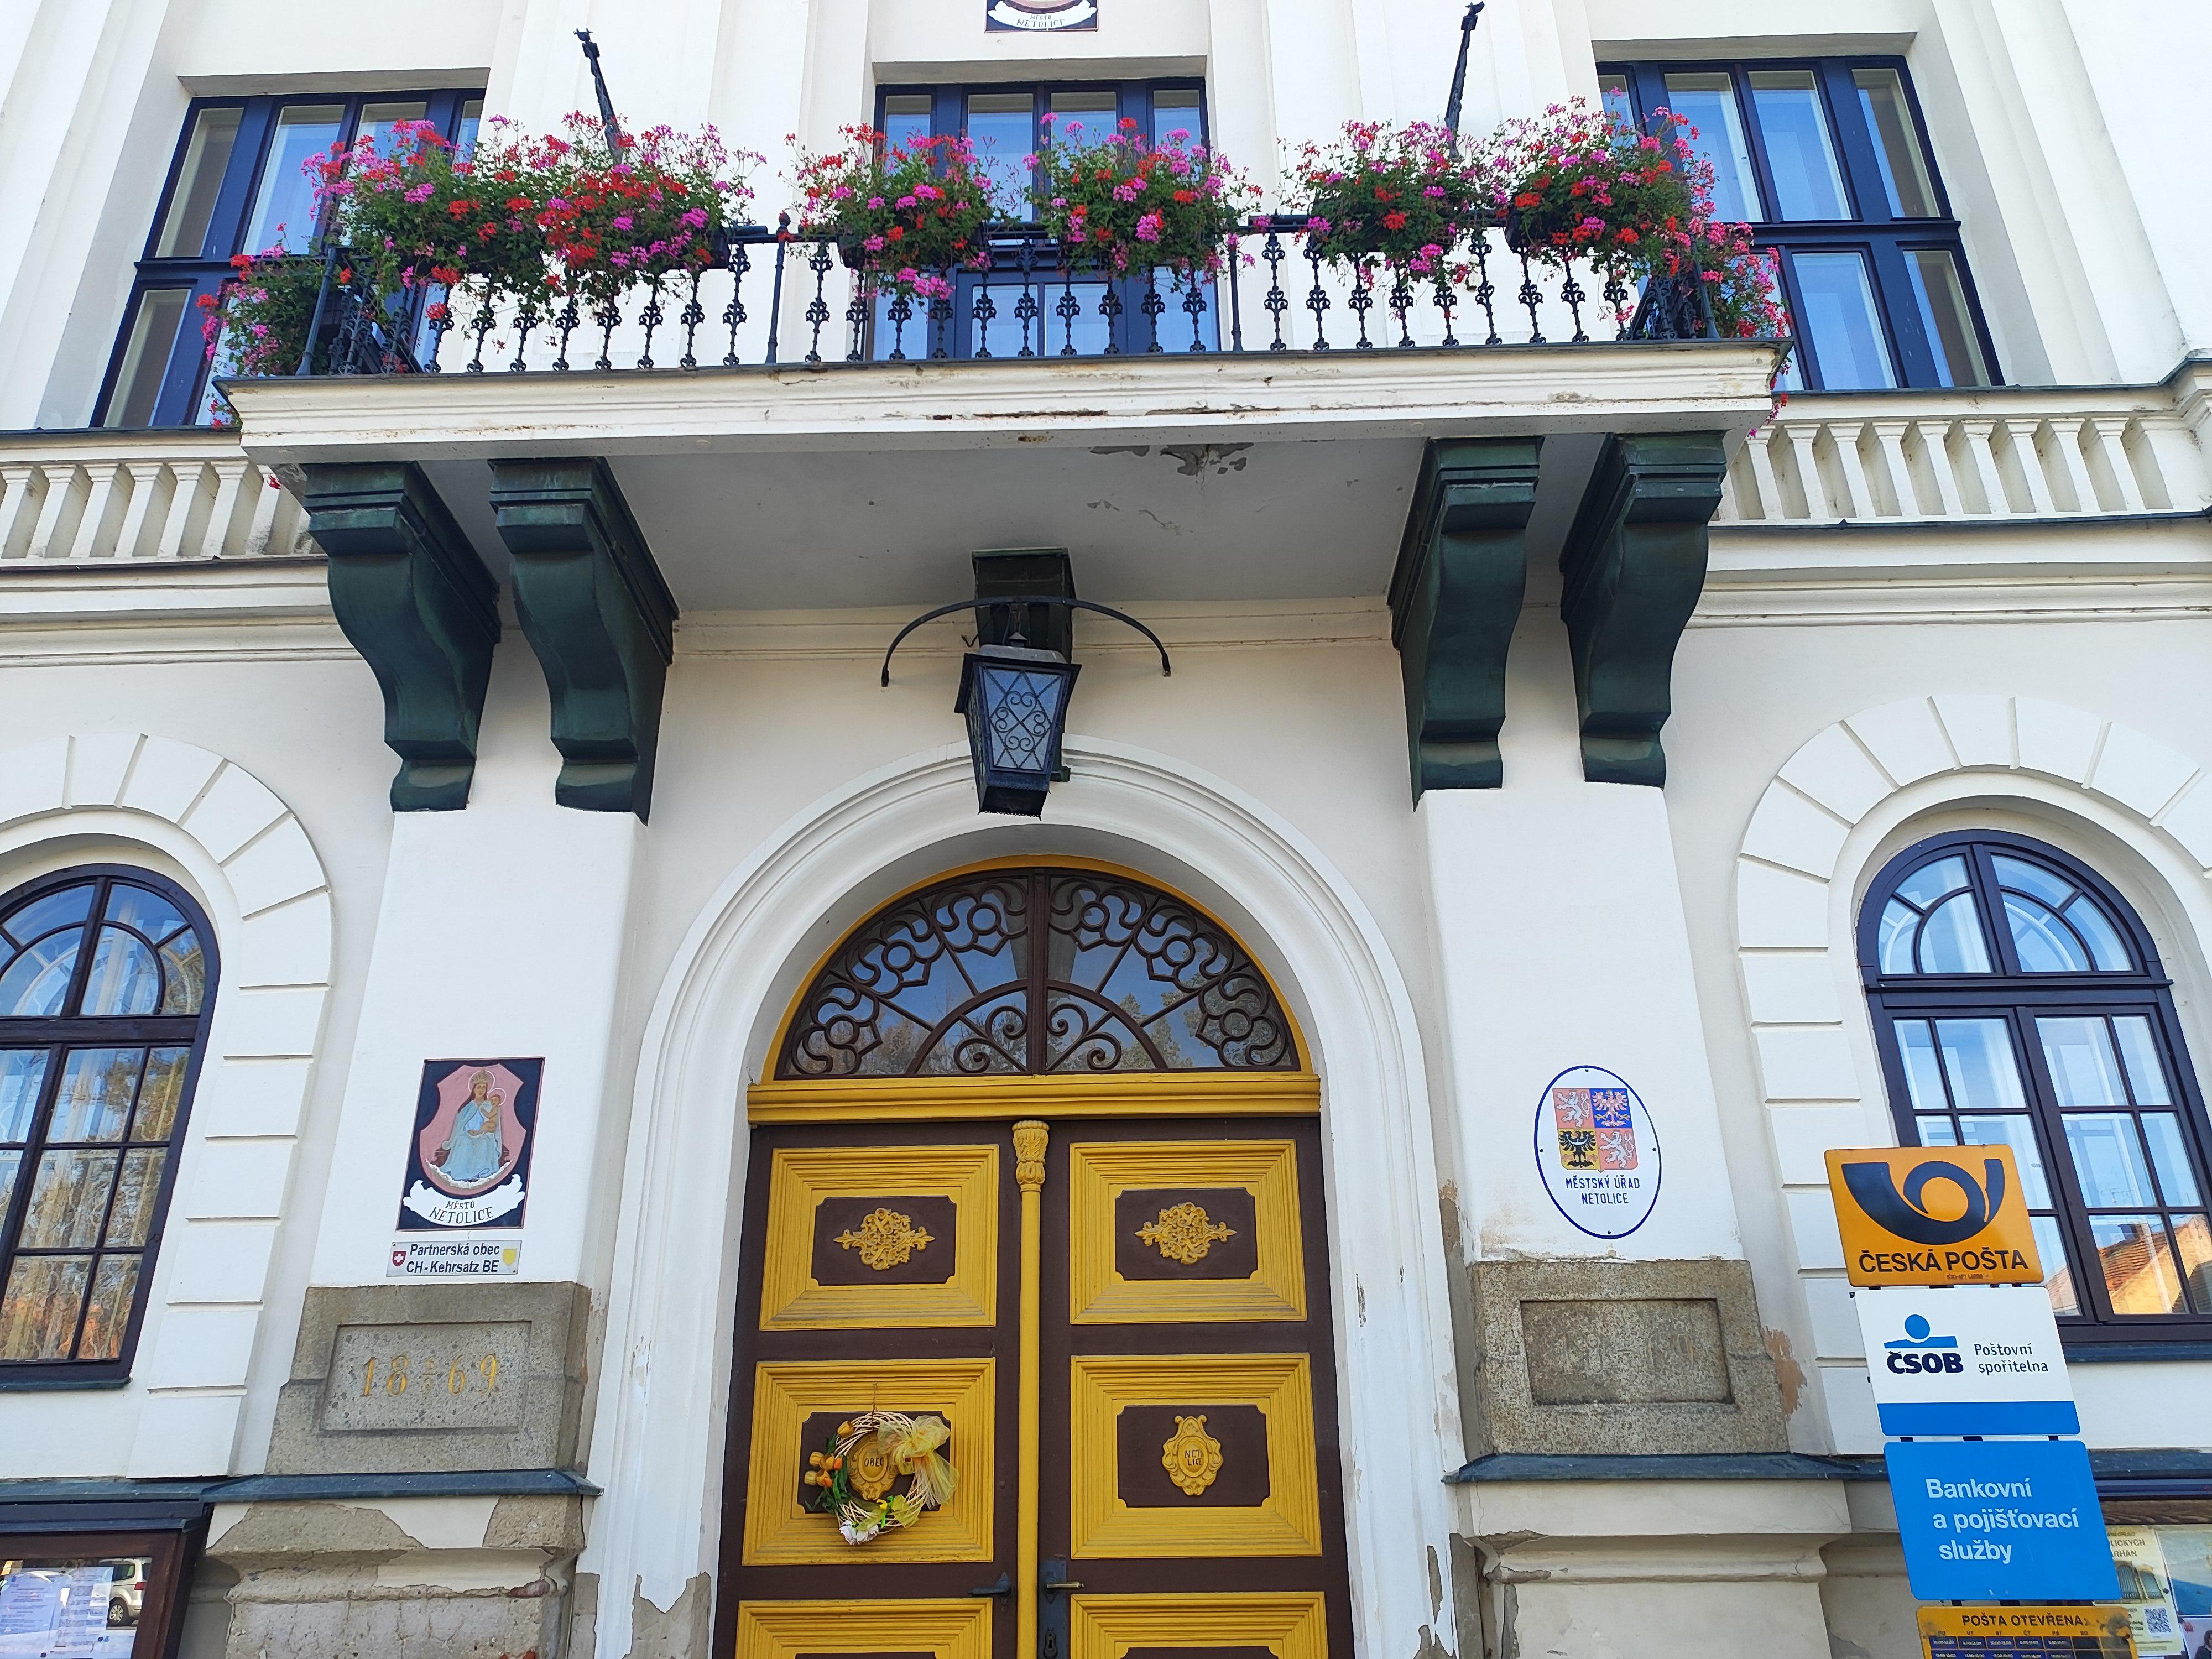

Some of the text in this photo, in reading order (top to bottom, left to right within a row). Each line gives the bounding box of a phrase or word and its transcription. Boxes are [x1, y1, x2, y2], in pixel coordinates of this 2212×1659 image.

[1016, 18, 1066, 27] NETOLICE
[1566, 1175, 1640, 1189] MĚSTSKÝ ÚŘAD
[445, 1201, 474, 1209] MĚSTO
[1581, 1193, 1629, 1204] NETOLICE
[429, 1207, 494, 1224] NETOLICE
[410, 1243, 500, 1256] Partnerská obec
[482, 1260, 499, 1272] BE
[1858, 1246, 2030, 1273] ČESKÁ POŠTA
[1974, 1343, 2033, 1357] Poštovní
[1886, 1350, 1964, 1375] ČSOB
[1979, 1359, 2049, 1376] spořitelna
[1924, 1477, 2032, 1499] Bankovní
[1933, 1507, 2079, 1534] a pojišťovací
[2110, 1538, 2146, 1547] LICKYCH
[1939, 1539, 2012, 1564] služby
[1961, 1612, 2007, 1626] POŠTA
